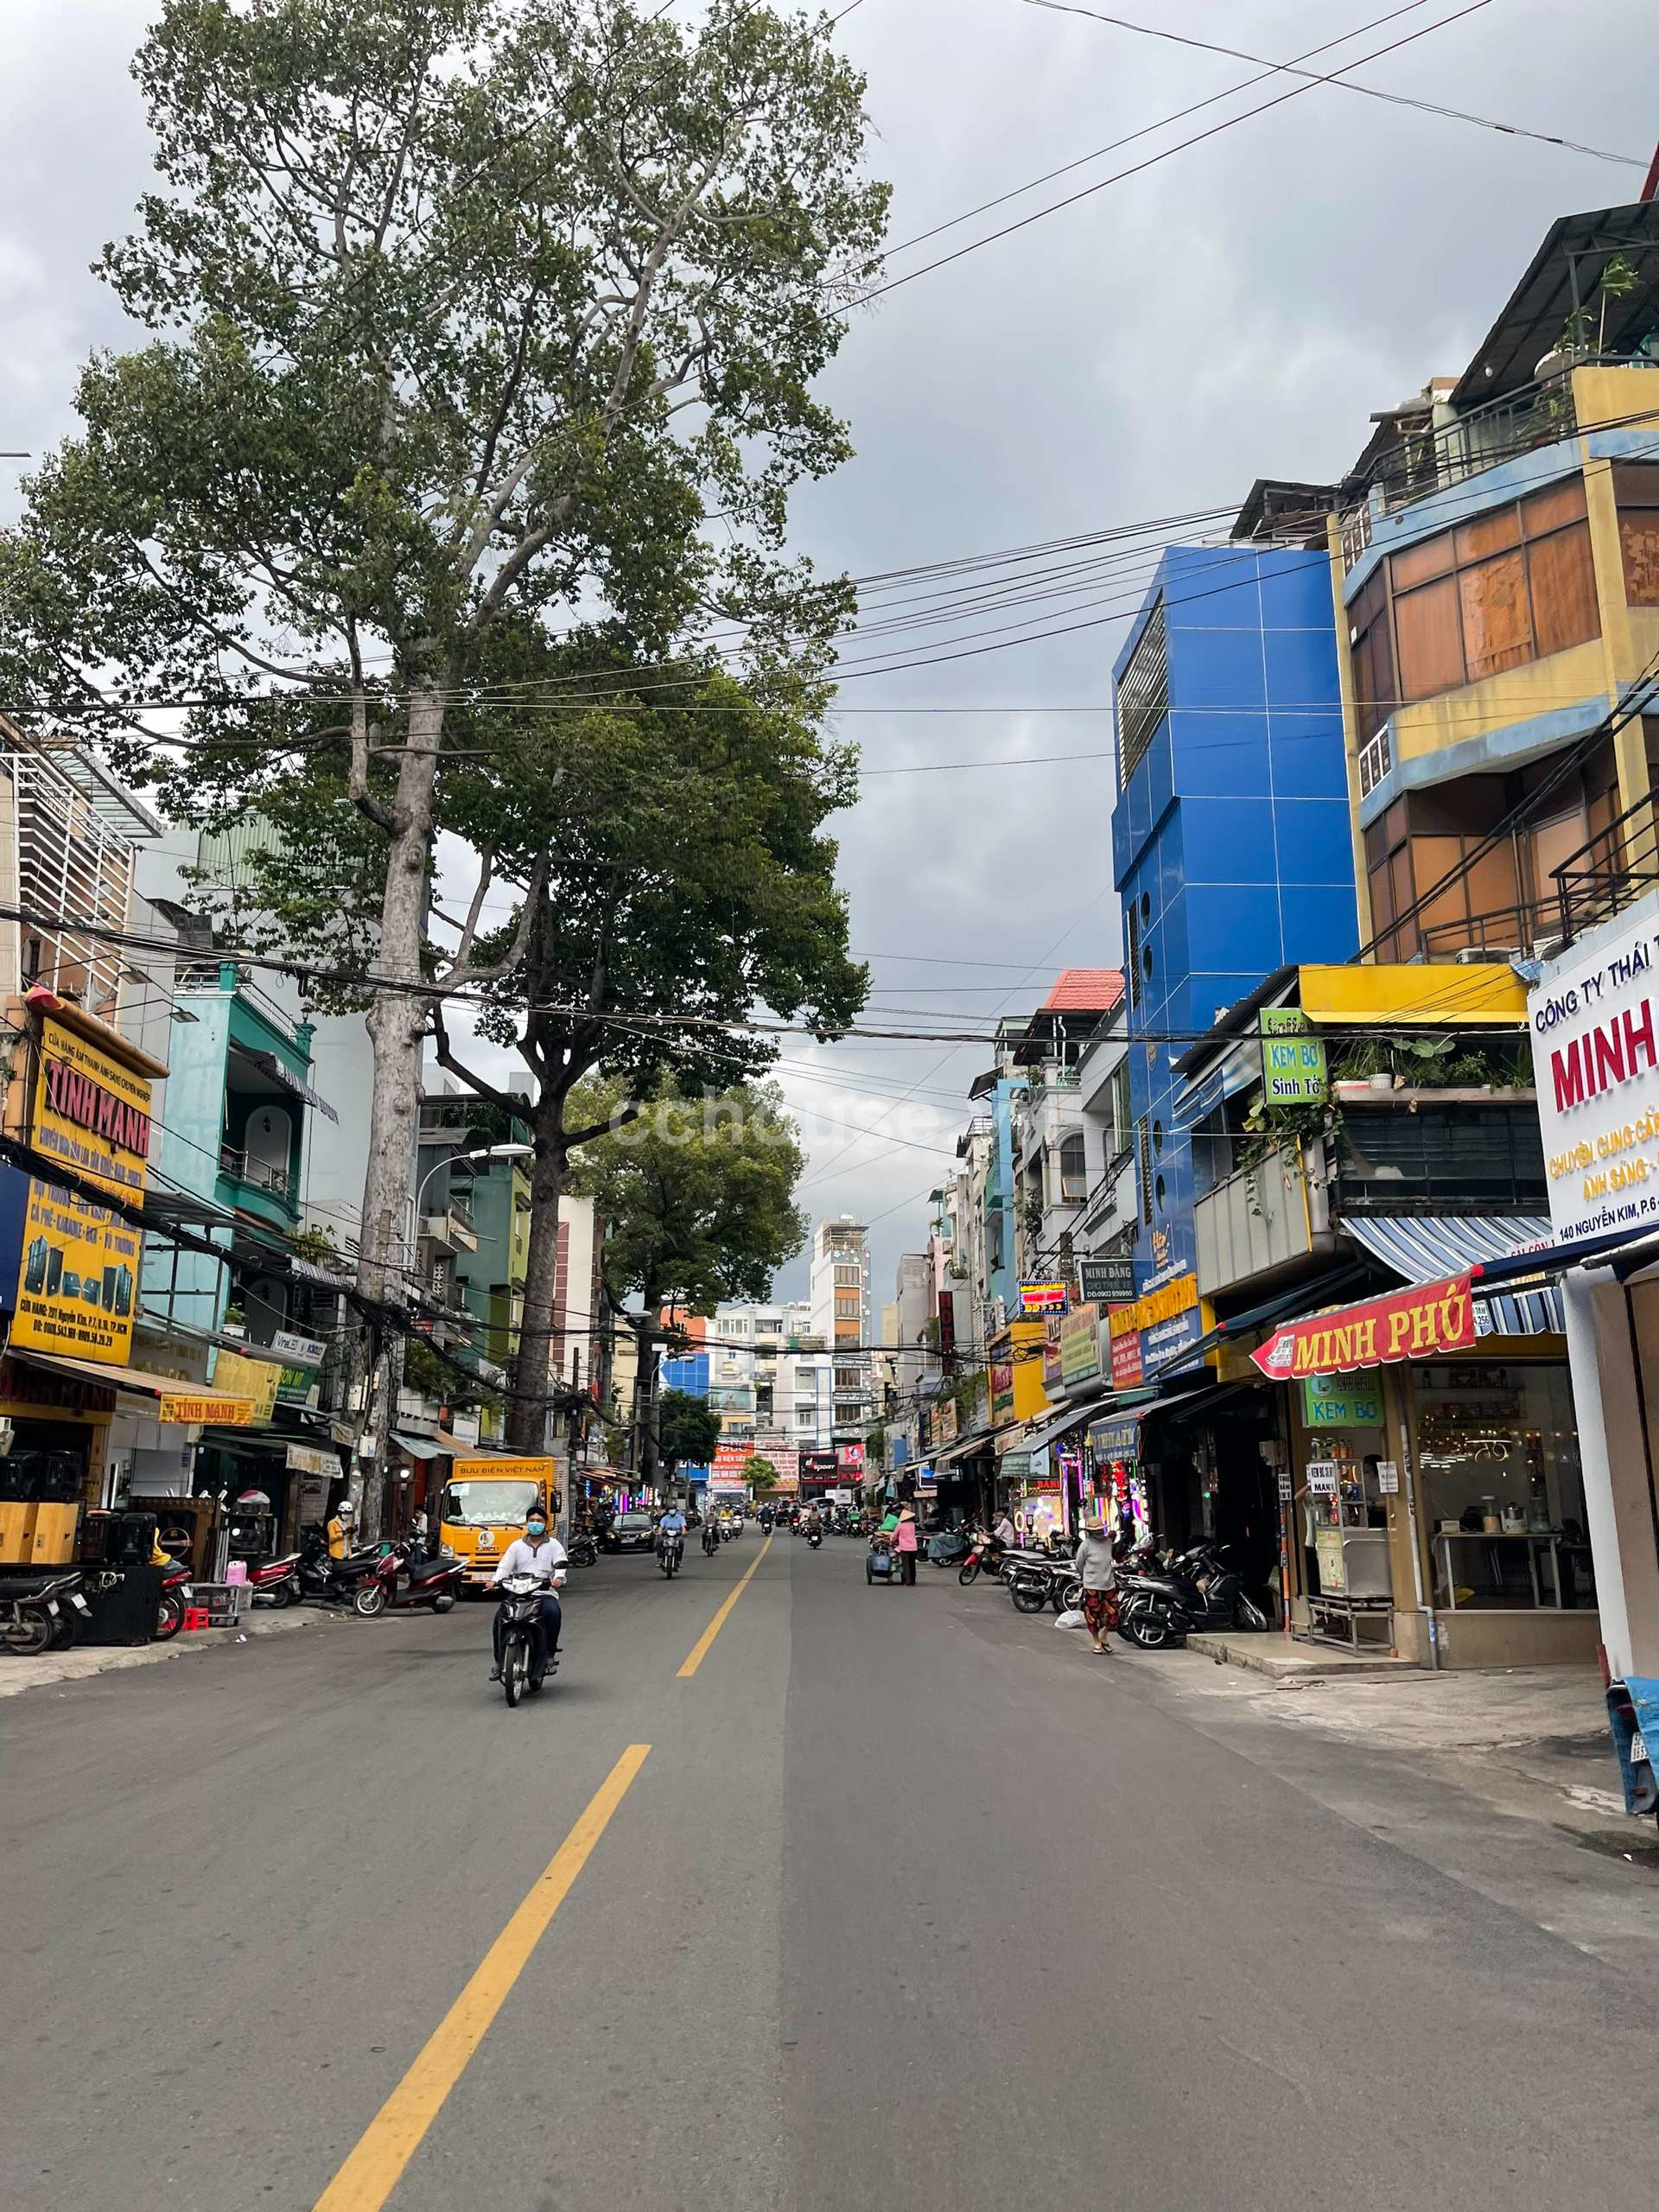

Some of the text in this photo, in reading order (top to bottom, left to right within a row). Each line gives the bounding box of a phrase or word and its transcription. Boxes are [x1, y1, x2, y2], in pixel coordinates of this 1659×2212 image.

[1535, 941, 1650, 1033] CÔNG TY THÁI
[1271, 1044, 1297, 1069] KEM
[1551, 998, 1657, 1114] MINH
[1272, 1074, 1320, 1096] Sinh Tố
[1549, 1140, 1595, 1181] CHUYÊN
[1596, 1124, 1633, 1159] CUNG
[1583, 1159, 1647, 1201] ÁNH SÁNG
[1560, 1196, 1656, 1242] 140 NGUYỄN KIM, P.6
[1085, 1267, 1107, 1279] MINH
[1294, 1318, 1377, 1370] MINH
[1389, 1283, 1466, 1354] PHÚ
[176, 1397, 204, 1418] TÍNH
[1313, 1401, 1347, 1421] KEM
